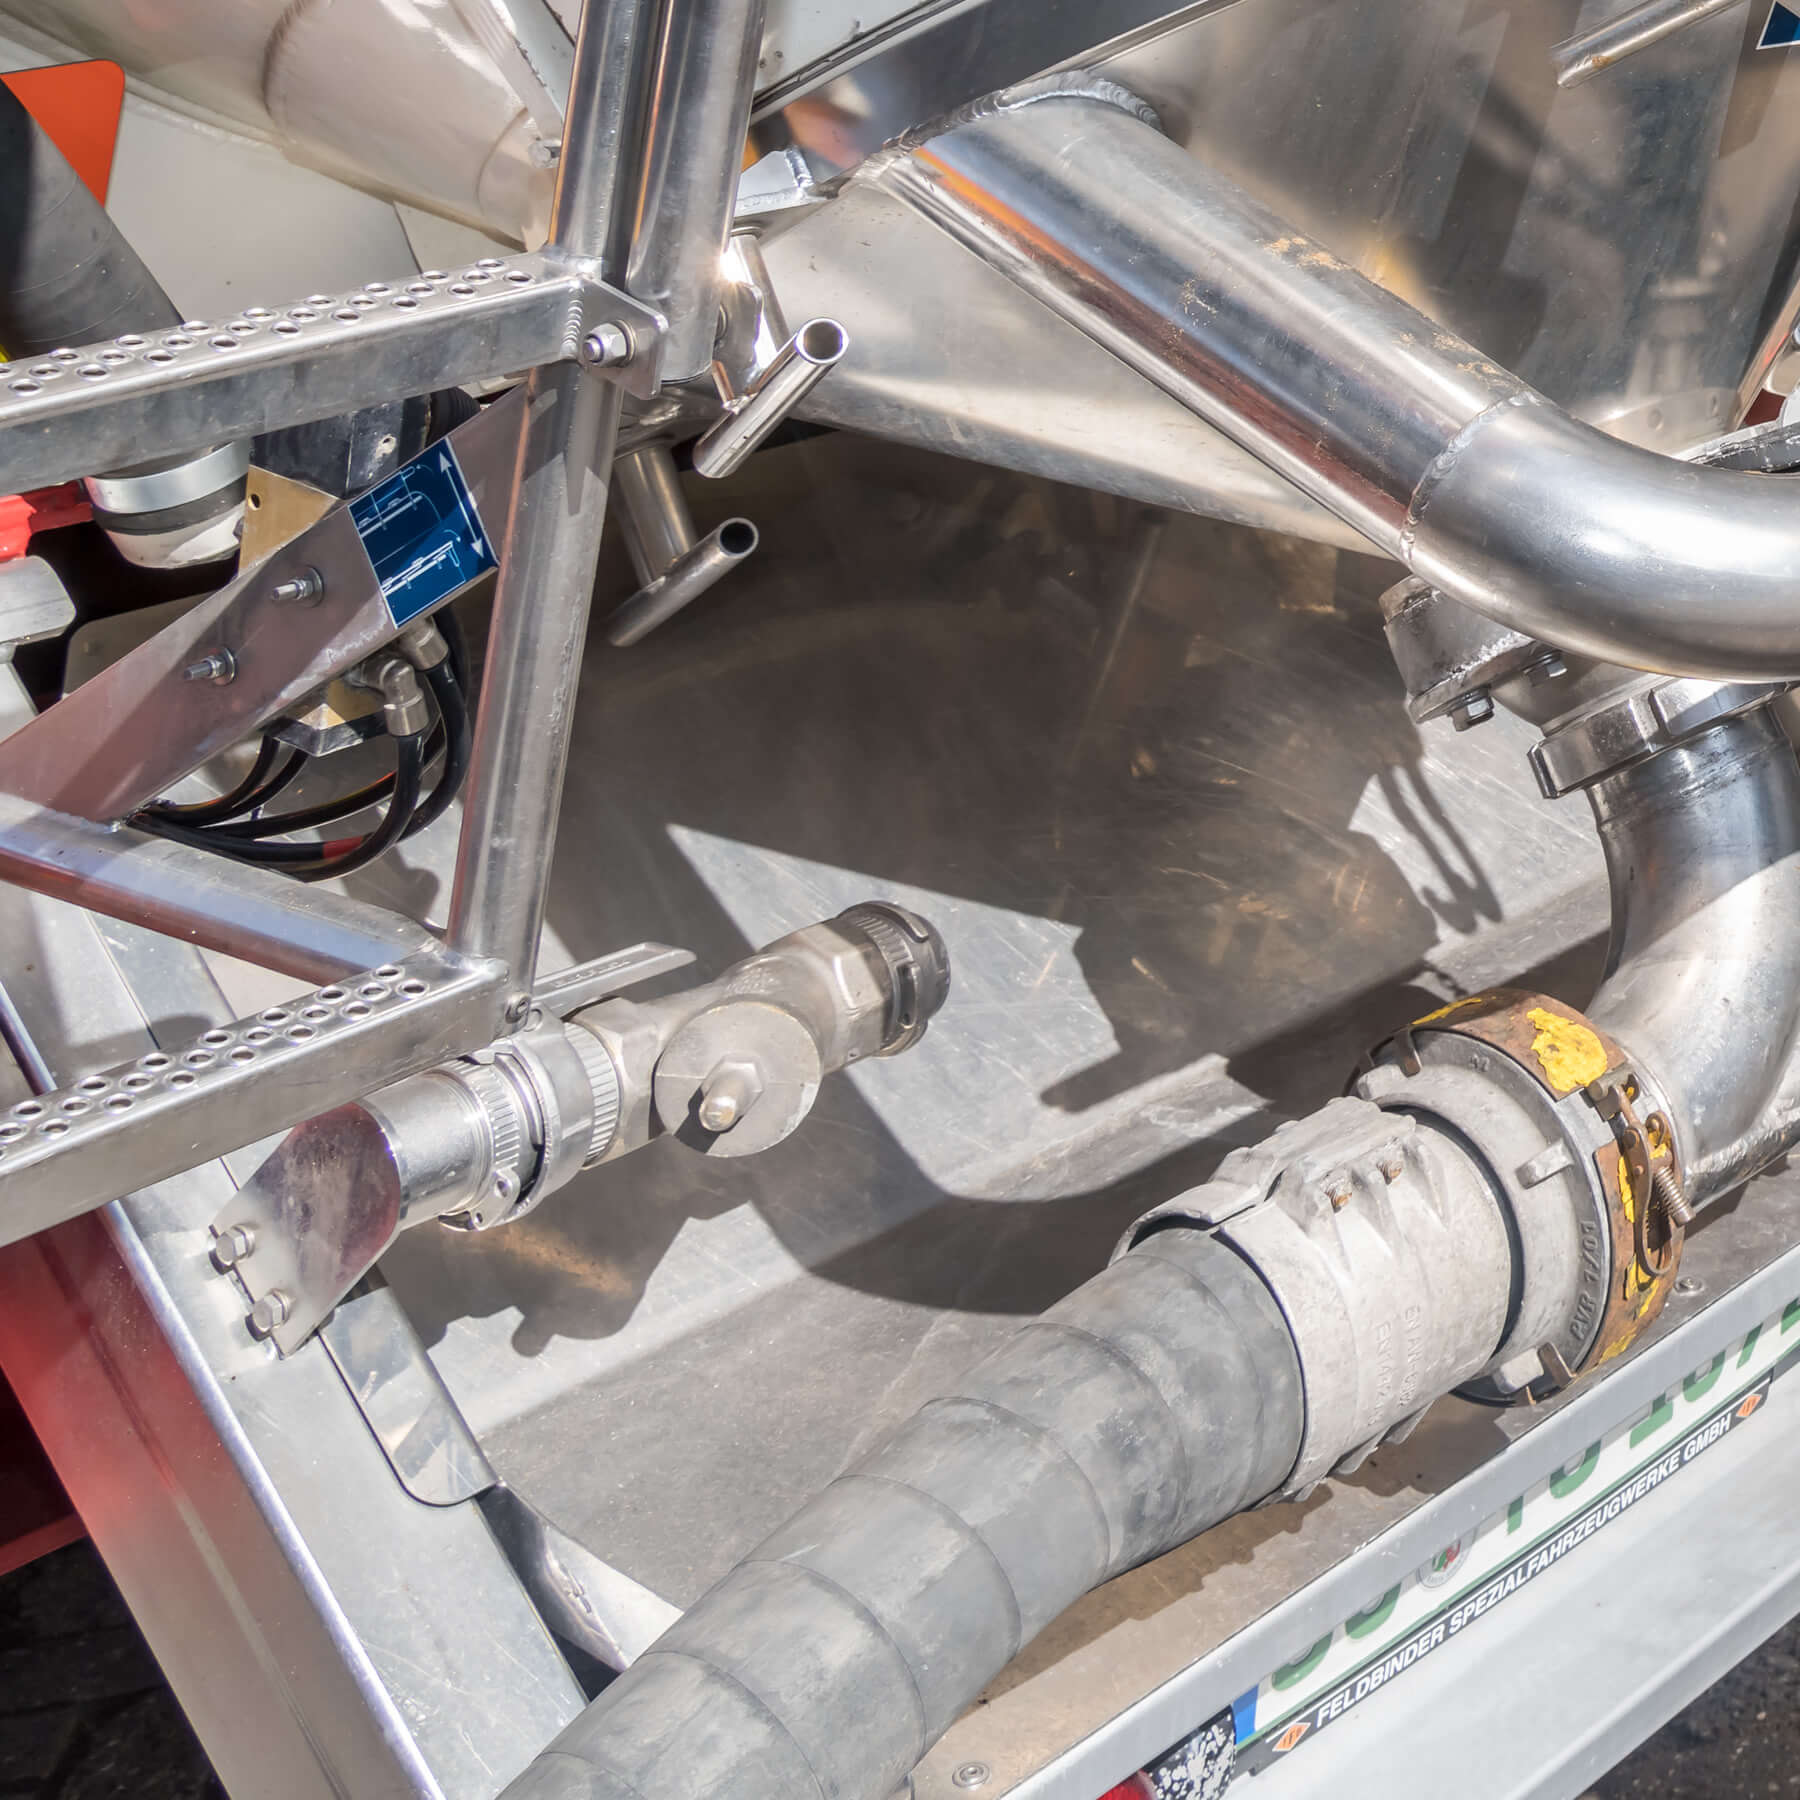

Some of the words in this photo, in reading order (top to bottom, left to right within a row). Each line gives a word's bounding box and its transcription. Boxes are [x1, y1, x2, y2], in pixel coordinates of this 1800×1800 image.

[1316, 1623, 1446, 1728] FELDBINDER
[1448, 1450, 1680, 1634] SPEZIALFAHRZEUGWERKE
[1683, 1412, 1732, 1461] GMBH
